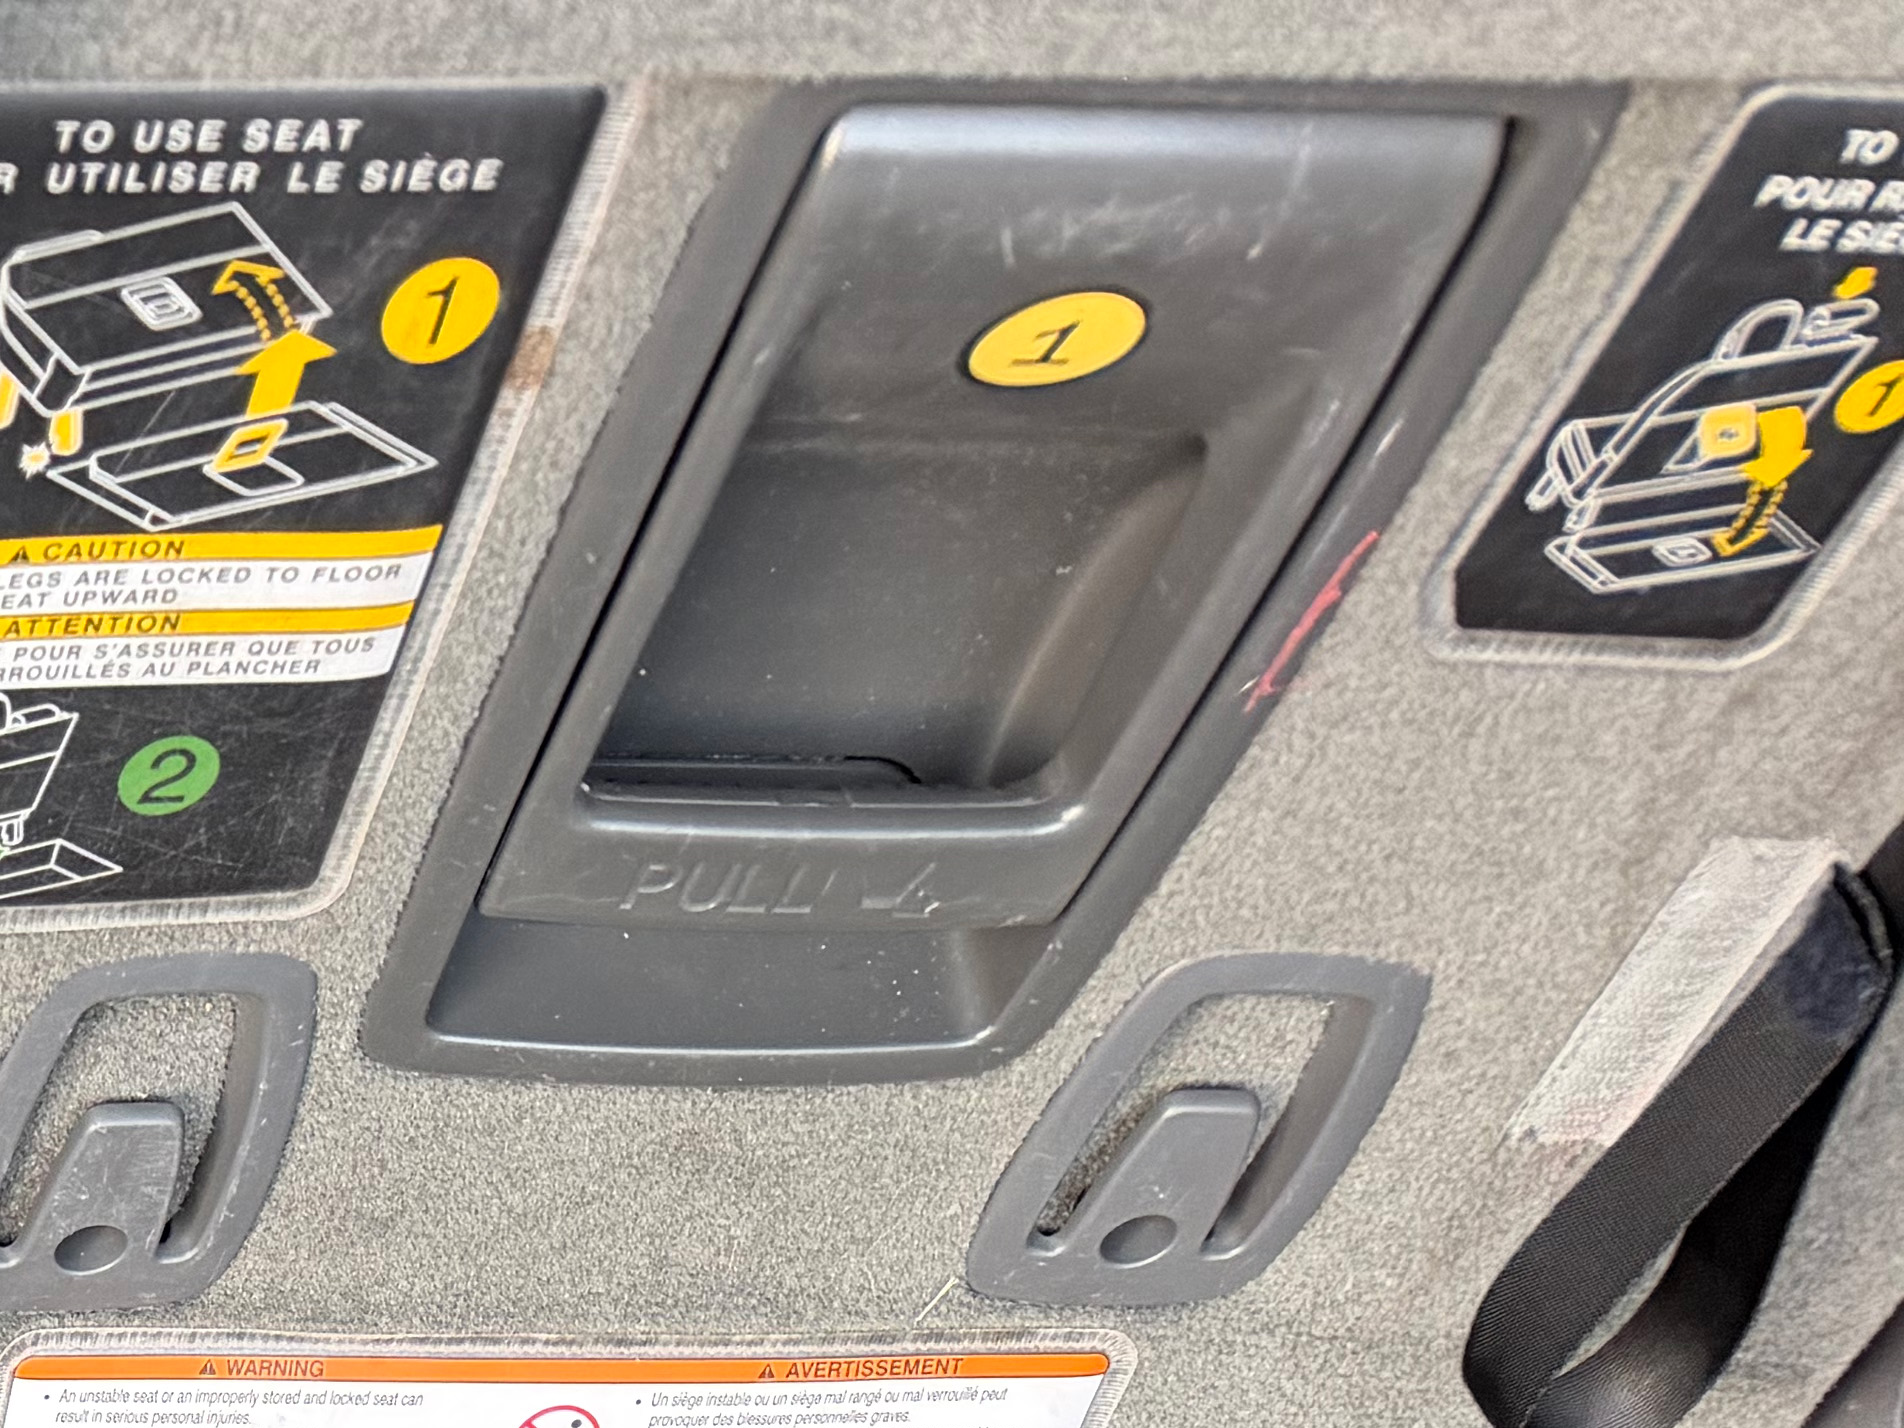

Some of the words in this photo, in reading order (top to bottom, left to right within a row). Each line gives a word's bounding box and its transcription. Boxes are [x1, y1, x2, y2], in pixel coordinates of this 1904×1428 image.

[54, 119, 115, 154] TO
[132, 119, 228, 154] USE
[240, 118, 362, 154] SEAT
[1840, 129, 1899, 165] TO
[44, 160, 261, 196] UTILISER
[287, 160, 346, 195] LE
[359, 153, 505, 195] SIÈGE
[1753, 175, 1875, 211] POUR
[1778, 218, 1843, 251] LE
[426, 276, 460, 346] 1
[1008, 319, 1081, 368] 1
[42, 540, 185, 561] CAUTION
[74, 568, 129, 586] ARE
[141, 566, 252, 585] LOCKED
[266, 566, 299, 584] TO
[310, 563, 402, 583] FLOOR
[63, 588, 178, 608] UPWARD
[3, 613, 181, 637] ATTENTION
[13, 644, 82, 663] POUR
[93, 640, 236, 659] S'ASSURER
[247, 638, 297, 656] QUE
[312, 636, 376, 655] TOUS
[142, 660, 175, 678] AU
[187, 659, 320, 677] PLANCHER
[137, 748, 196, 804] 2
[619, 862, 812, 913] PULL
[226, 1359, 325, 1378] WARNING
[785, 1358, 964, 1379] AVERTISSEMENT
[59, 1388, 77, 1403] An
[79, 1388, 131, 1404] unstable
[133, 1389, 159, 1403] seat
[161, 1391, 175, 1403] or
[177, 1391, 192, 1403] an
[195, 1389, 260, 1408] improperly
[262, 1389, 302, 1405] stored
[304, 1390, 327, 1405] and
[330, 1390, 371, 1406] locked
[373, 1392, 398, 1406] seat
[401, 1393, 424, 1406] can
